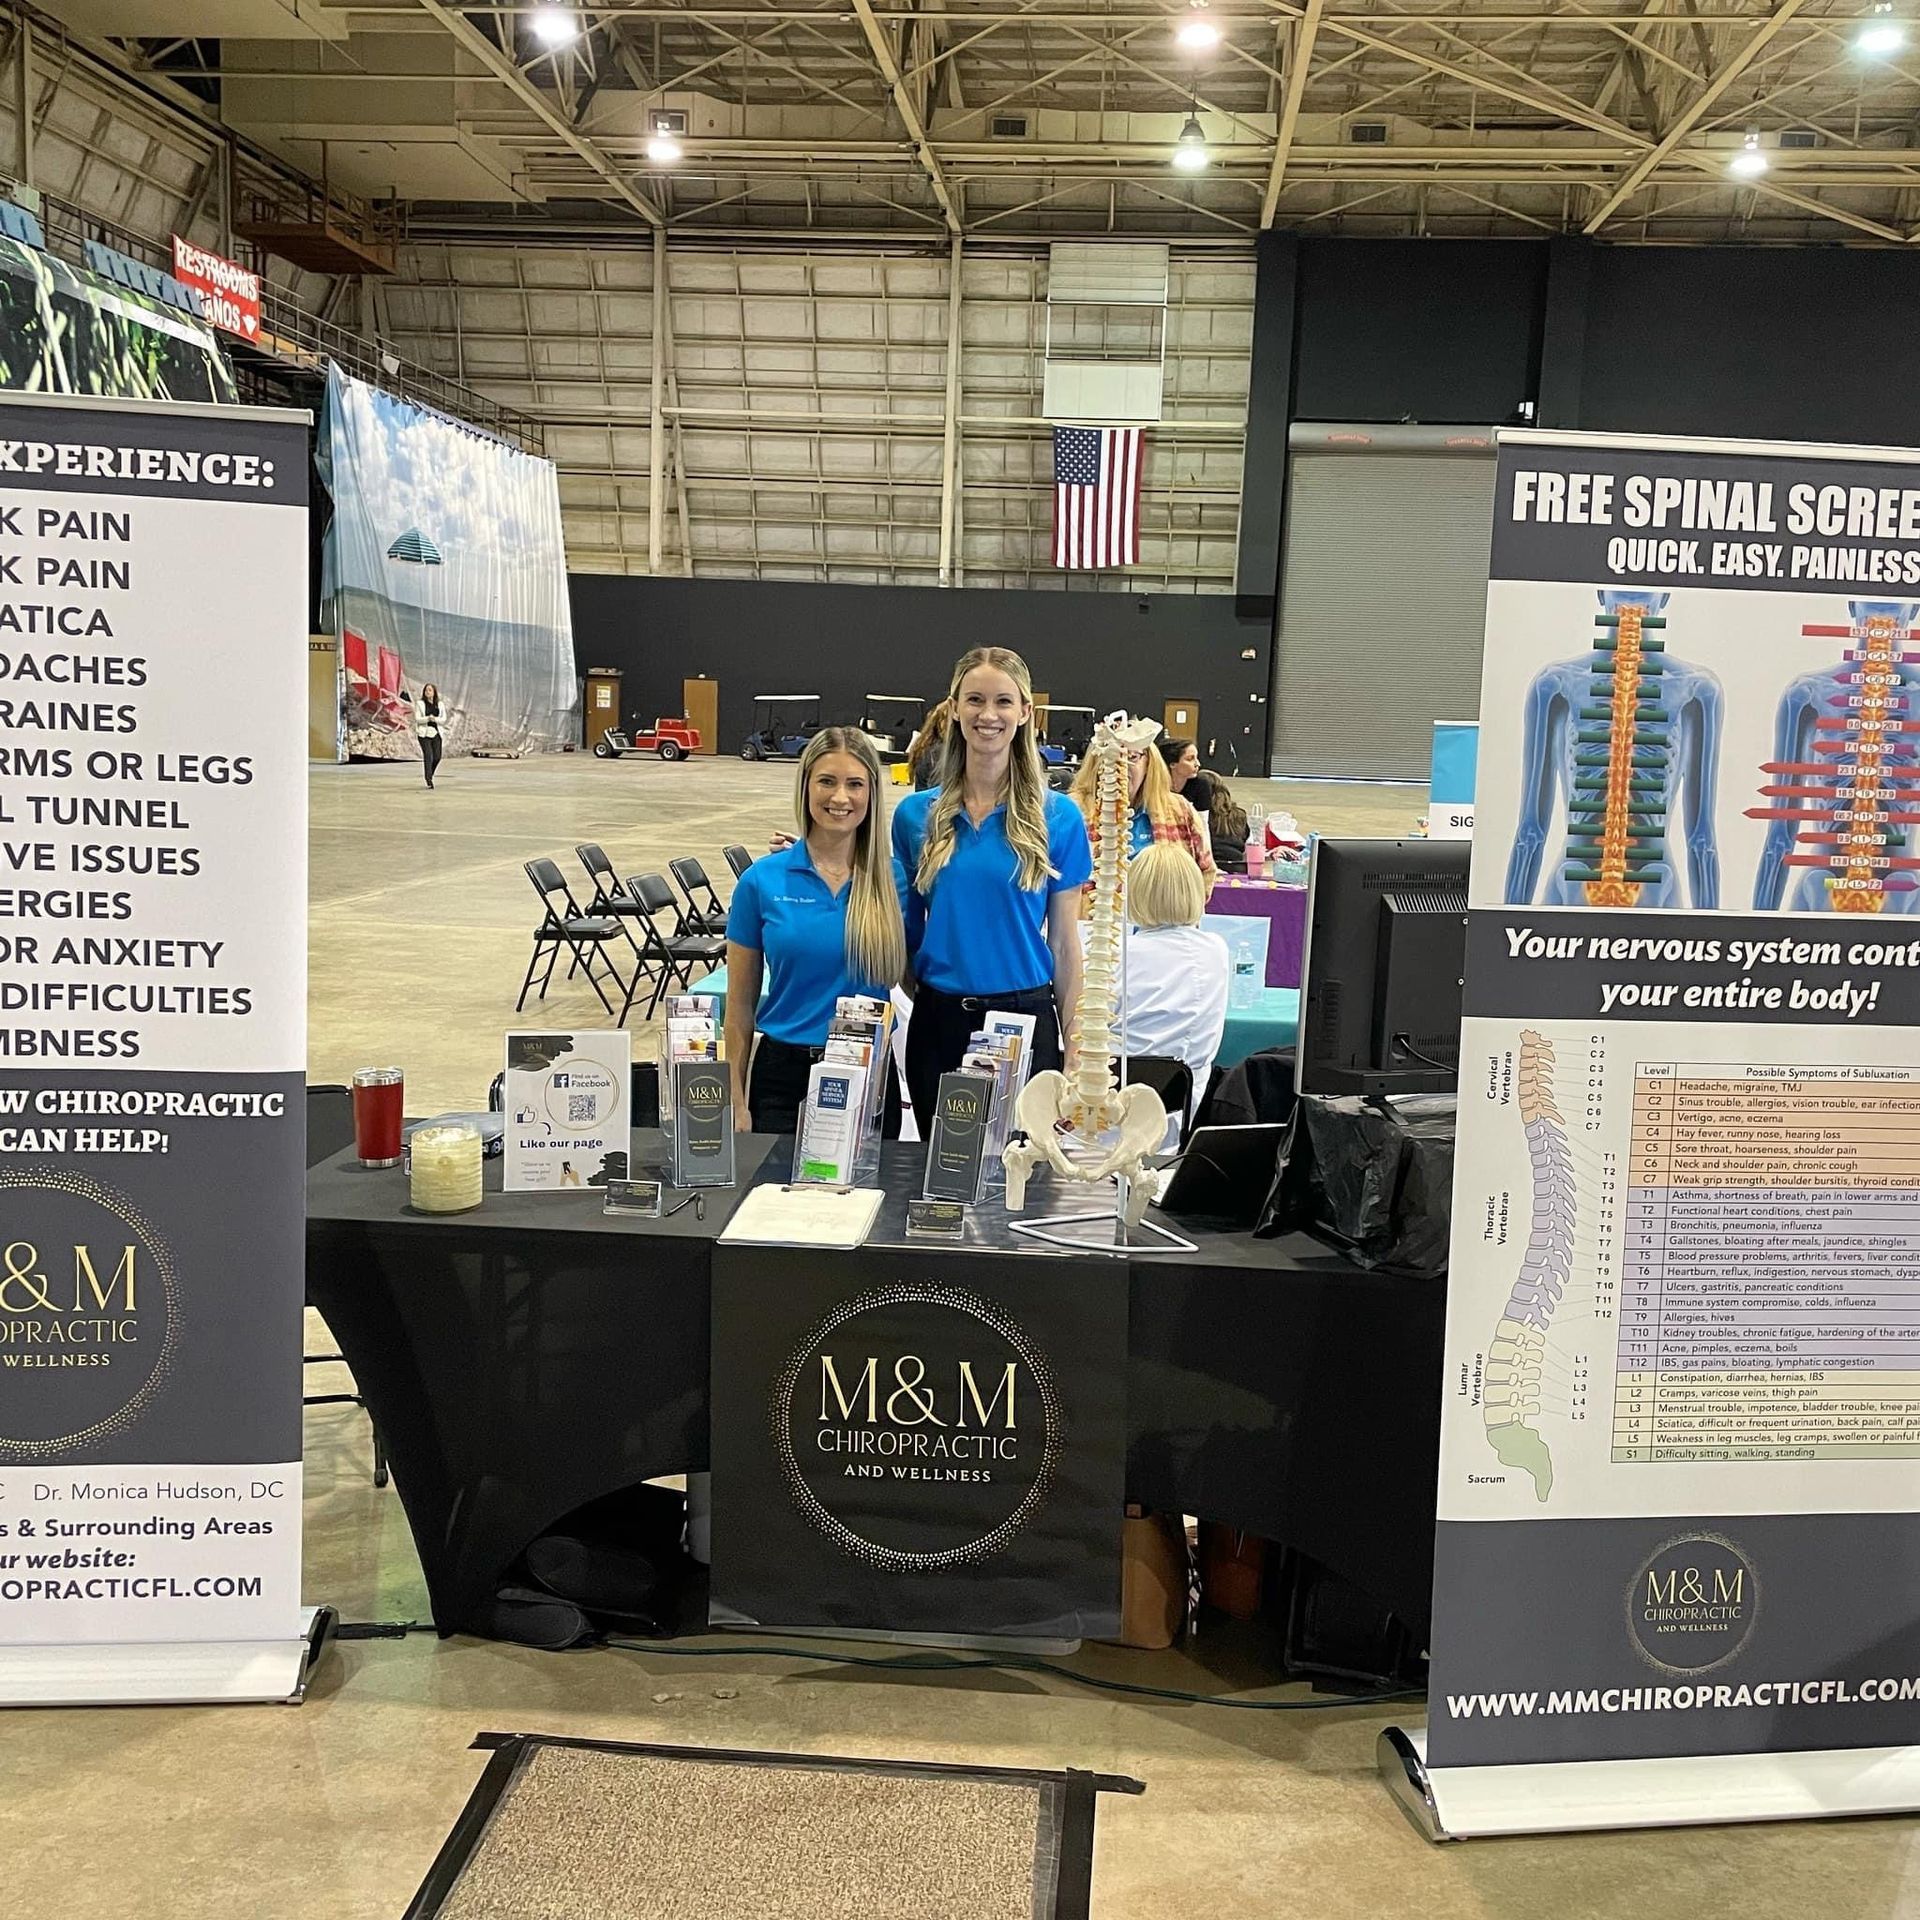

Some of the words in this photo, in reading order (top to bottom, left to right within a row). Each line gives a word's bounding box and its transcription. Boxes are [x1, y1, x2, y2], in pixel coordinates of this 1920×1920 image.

[176, 240, 257, 302] RESTROOMS
[0, 440, 274, 487] XPERIENCE:
[1512, 471, 1614, 525] FREE
[1623, 475, 1776, 532] SPINAL
[1787, 484, 1920, 539] SCREE
[38, 508, 130, 541] PAIN
[38, 557, 130, 590] PAIN
[1607, 537, 1704, 575] QUICK.
[1711, 542, 1784, 578] EASY.
[1790, 546, 1920, 583] PAINLESS
[0, 604, 113, 637] ATICA
[0, 701, 137, 733] RAINES
[87, 751, 143, 781] OR
[158, 754, 253, 785] LEGS
[27, 796, 190, 829] TUNNEL
[1450, 816, 1474, 827] SIG
[3, 843, 55, 871] VE
[71, 844, 200, 876] ISSUES
[0, 890, 132, 920] ERGIES
[51, 938, 224, 968] ANXIETY
[1505, 928, 1583, 960] Your
[1587, 936, 1720, 963] nervous
[1727, 937, 1841, 970] system
[1847, 940, 1920, 968] cont
[1, 984, 252, 1015] DIFFICULTIES
[1599, 981, 1679, 1013] your
[1684, 978, 1782, 1010] entire
[1789, 980, 1880, 1018] body!
[1487, 1056, 1498, 1100] Cervical
[1501, 1052, 1512, 1105] Vertebrae
[1644, 1066, 1669, 1075] Level
[1746, 1068, 1786, 1077] Possible
[1789, 1068, 1838, 1080] Symptoms
[1840, 1069, 1850, 1078] of
[1853, 1069, 1910, 1079] Subluxation
[689, 1086, 722, 1099] M&M
[1649, 1081, 1662, 1090] C1
[1680, 1082, 1730, 1092] Headache,
[1733, 1083, 1778, 1094] migraine,
[1782, 1084, 1802, 1092] TMJ
[36, 1090, 284, 1117] CHIROPRACTIC
[946, 1099, 976, 1114] M&M
[1648, 1097, 1662, 1105] C2
[1679, 1098, 1703, 1106] Sinus
[1706, 1098, 1744, 1108] trouble,
[1747, 1098, 1789, 1110] allergies,
[1792, 1099, 1819, 1108] vision
[1822, 1100, 1858, 1110] trouble,
[1648, 1112, 1660, 1121] C3
[1678, 1114, 1716, 1124] Vertigo,
[1719, 1115, 1744, 1124] acne,
[0, 1128, 67, 1152] CAN
[73, 1129, 170, 1154] HELP!
[520, 1140, 545, 1148] Like
[574, 1139, 602, 1149] page
[1646, 1128, 1659, 1137] C4
[1677, 1129, 1695, 1140] Hay
[1698, 1130, 1724, 1139] fever,
[1727, 1132, 1753, 1140] runny
[1757, 1132, 1783, 1140] nose,
[1786, 1130, 1820, 1141] hearing
[1823, 1130, 1840, 1139] loss
[1646, 1144, 1658, 1152] C5
[1676, 1144, 1697, 1153] Sore
[1700, 1145, 1732, 1154] throat,
[1735, 1145, 1791, 1155] hoarseness,
[1794, 1146, 1834, 1154] shoulder
[1837, 1146, 1856, 1156] pain
[1644, 1160, 1657, 1168] C6
[1675, 1160, 1699, 1169] Neck
[1703, 1160, 1720, 1169] and
[1722, 1161, 1764, 1170] shoulder
[1767, 1161, 1790, 1172] pain,
[1793, 1161, 1826, 1170] chronic
[1829, 1161, 1857, 1172] cough
[1643, 1175, 1656, 1184] C7
[1674, 1176, 1700, 1184] Weak
[1703, 1176, 1722, 1187] grip
[1725, 1176, 1768, 1187] strength,
[1771, 1176, 1811, 1185] shoulder
[1814, 1177, 1850, 1186] bursitis,
[1854, 1177, 1887, 1188] thyroid
[1484, 1195, 1495, 1240] Thoracic
[1497, 1192, 1509, 1245] Vertebrae
[1641, 1221, 1653, 1230] T3
[1670, 1221, 1719, 1231] Bronchitis,
[1722, 1222, 1778, 1232] pneumonia,
[1781, 1222, 1822, 1230] influenza
[1635, 1313, 1647, 1322] T9
[1664, 1313, 1707, 1324] Allergies,
[1711, 1314, 1734, 1322] hives
[3, 1354, 110, 1368] WELLNESS
[818, 1355, 1018, 1429] M&M
[1458, 1363, 1468, 1396] Lumar
[1472, 1353, 1482, 1406] Vertebrae
[1632, 1374, 1642, 1382] L1
[1661, 1373, 1722, 1384] Constipation,
[1726, 1373, 1767, 1383] diarrhea,
[1770, 1373, 1806, 1382] hernias,
[1809, 1373, 1824, 1382] IBS
[817, 1429, 1017, 1460] CHIROPRACTIC
[1626, 1450, 1637, 1458] S1
[1656, 1449, 1696, 1460] Difficulty
[1700, 1449, 1731, 1460] sitting,
[1734, 1448, 1772, 1460] walking,
[1776, 1448, 1814, 1459] standing
[844, 1464, 884, 1479] AND
[892, 1466, 991, 1482] WELLNESS
[1468, 1475, 1505, 1484] Sacrum
[34, 1483, 62, 1501] Dr.
[71, 1482, 148, 1500] Monica
[156, 1481, 242, 1501] Hudson,
[251, 1480, 284, 1498] DC
[18, 1519, 36, 1537] &
[45, 1517, 195, 1539] Surrounding
[204, 1517, 273, 1535] Areas
[26, 1547, 135, 1568] website:
[1, 1577, 261, 1599] OPRACTICFL.COM
[1646, 1568, 1743, 1605] M&M
[1644, 1607, 1742, 1620] CHIROPRACTIC
[1447, 1678, 1920, 1718] WWW.MMCHIROPRACTICFL.COM
